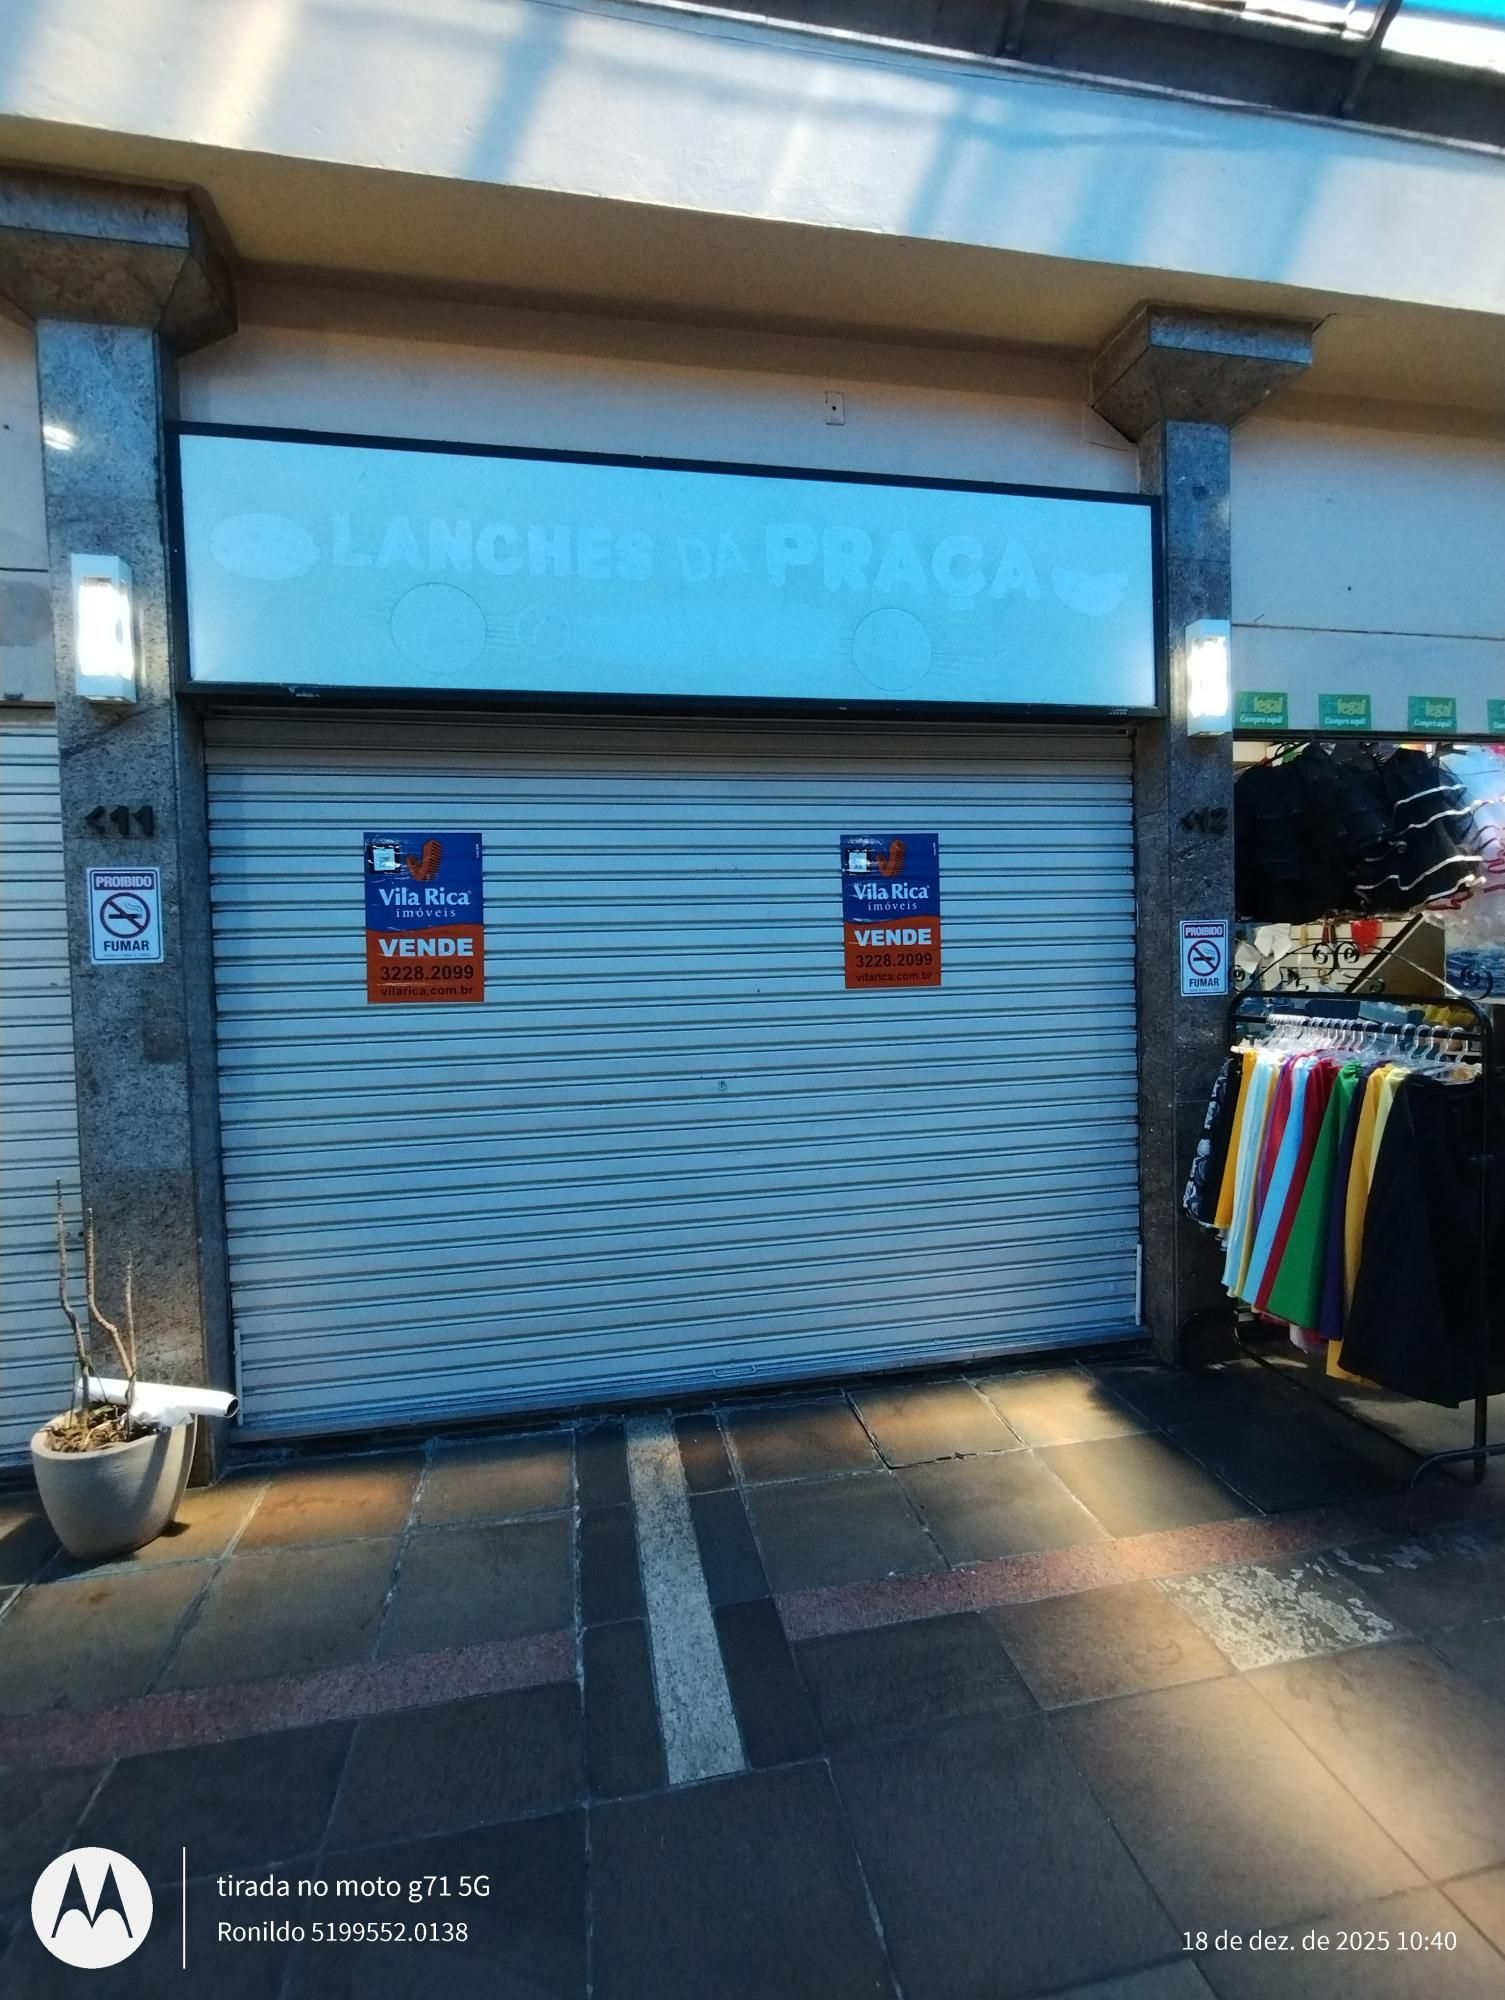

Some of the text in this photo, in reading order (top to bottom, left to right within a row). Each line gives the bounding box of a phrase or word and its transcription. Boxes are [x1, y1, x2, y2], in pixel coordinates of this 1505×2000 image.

[332, 511, 1043, 611] LANCHES DA PRAÇA
[95, 875, 153, 888] PROIBIDO
[378, 886, 471, 907] Vila Rica
[853, 883, 929, 900] Vila Rica
[395, 907, 457, 918] imóveis
[867, 901, 918, 911] imóveis
[854, 928, 932, 946] VENDE
[1184, 925, 1224, 937] PROIBIDO
[103, 940, 150, 952] FUMAR
[378, 938, 475, 957] VENDE
[855, 952, 933, 968] 3228.2099
[380, 964, 475, 981] 3228.2099
[856, 970, 933, 983] vilarica.com.br
[1189, 977, 1220, 988] FUMAR
[381, 984, 475, 997] vilarica.com.br
